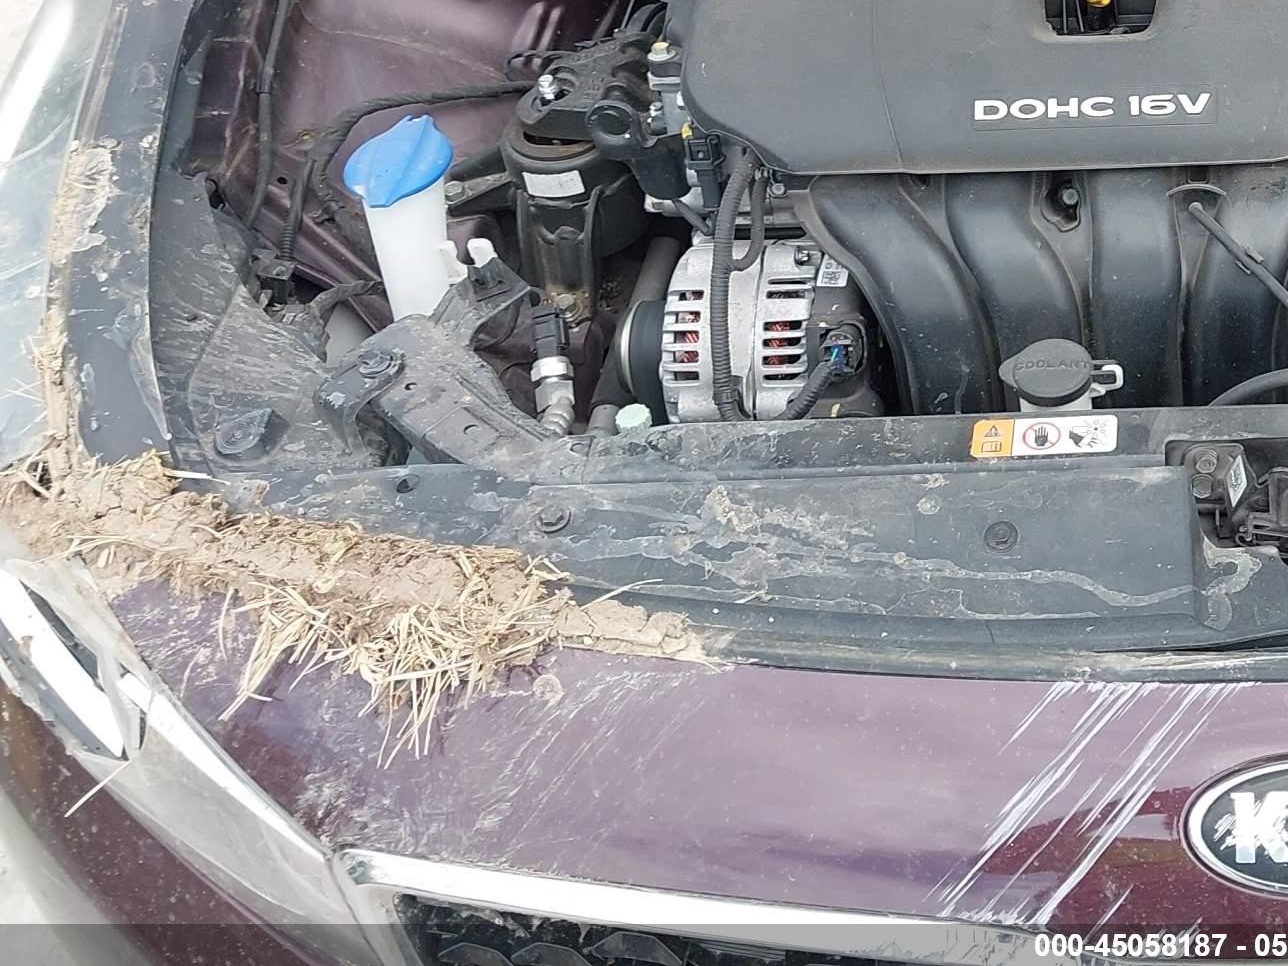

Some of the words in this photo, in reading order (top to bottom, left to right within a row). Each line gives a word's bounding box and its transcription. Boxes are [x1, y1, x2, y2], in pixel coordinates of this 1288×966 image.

[974, 96, 1114, 122] DOHC
[1128, 92, 1212, 116] 16V
[1015, 359, 1090, 371] COOLANT
